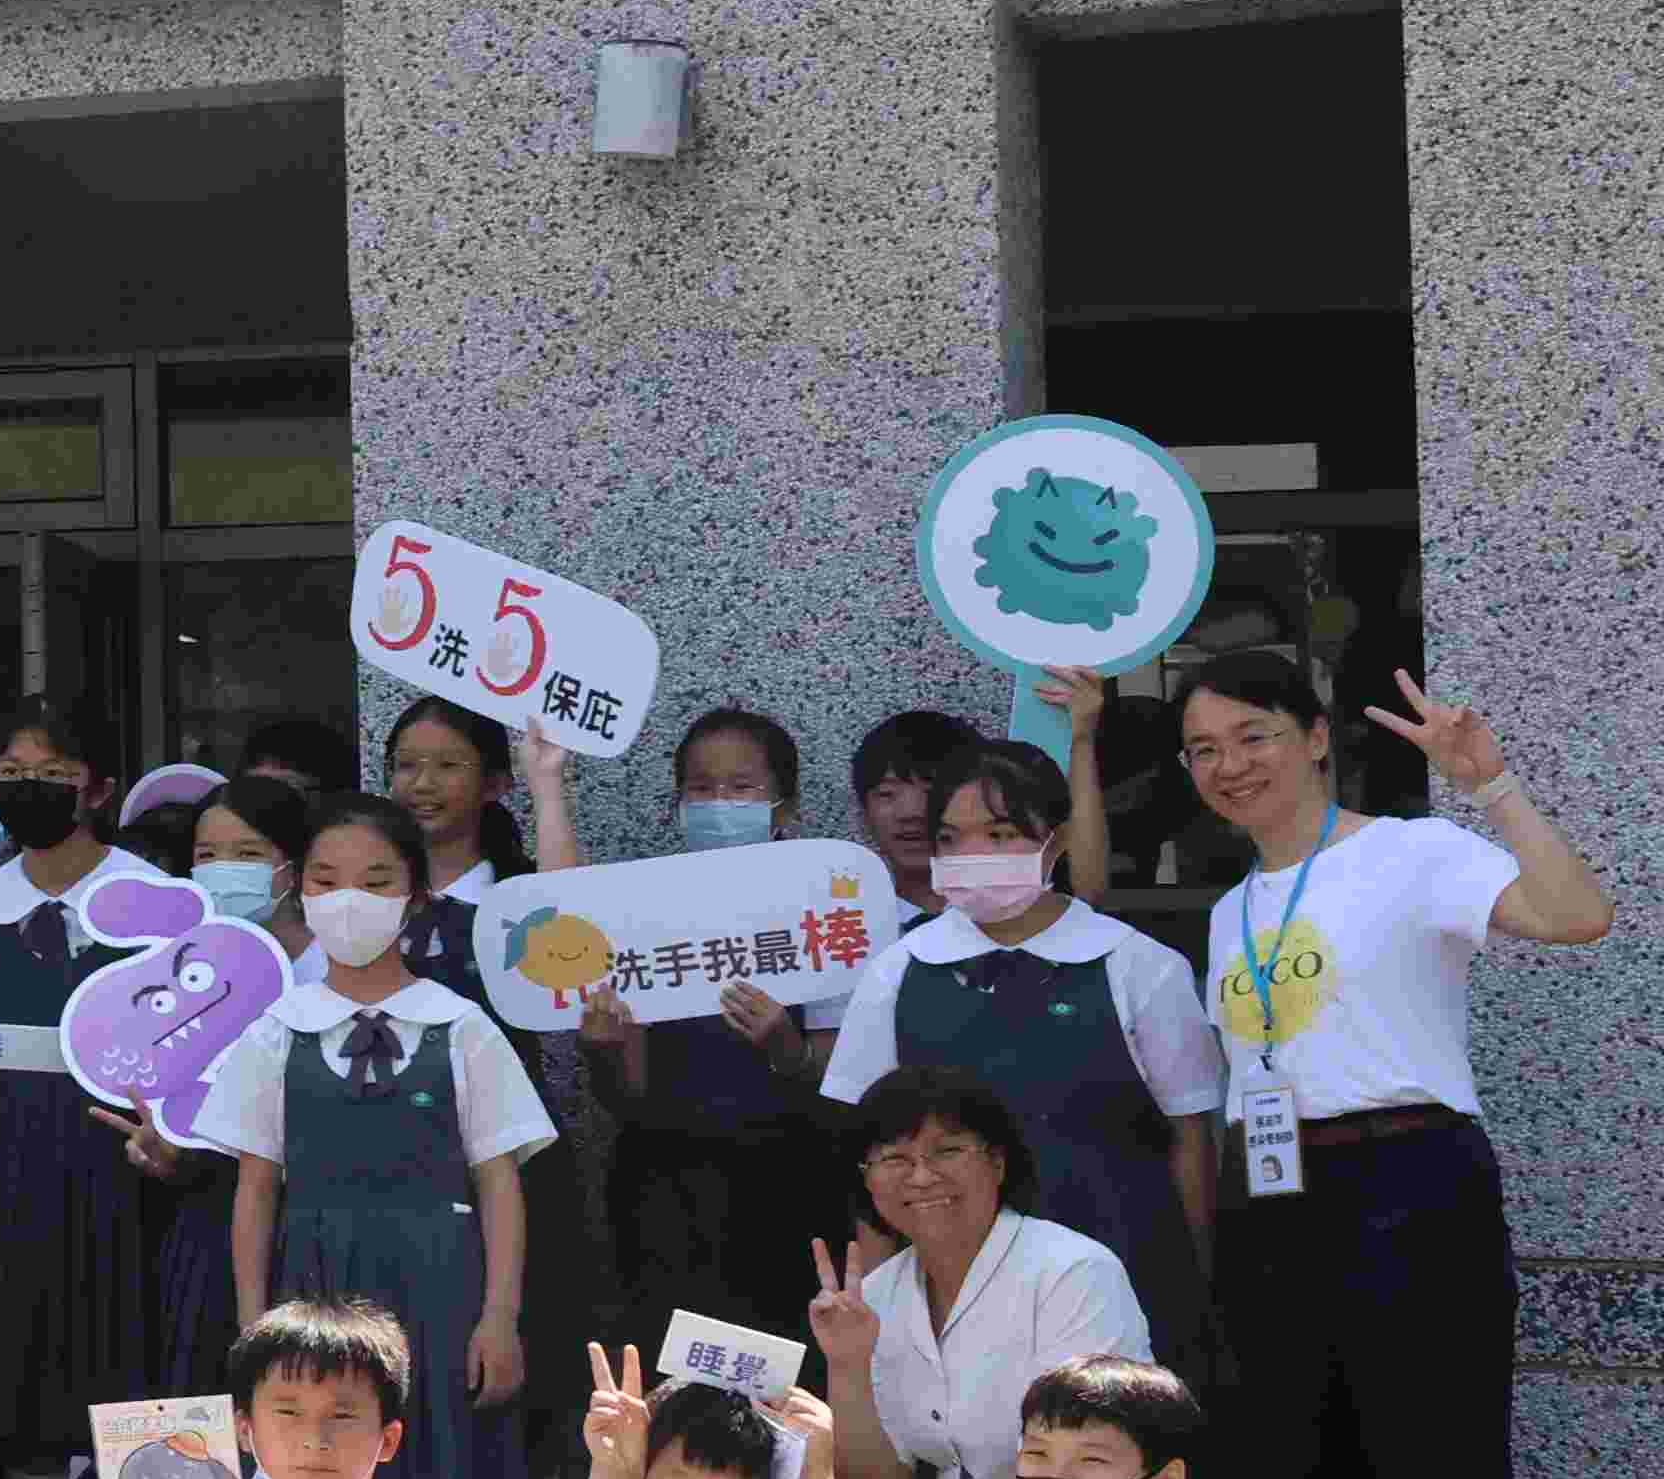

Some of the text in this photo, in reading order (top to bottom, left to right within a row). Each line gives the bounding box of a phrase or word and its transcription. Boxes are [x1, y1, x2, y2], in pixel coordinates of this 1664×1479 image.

[606, 905, 871, 993] 洗手我最棒
[686, 1340, 768, 1390] 睡覺
